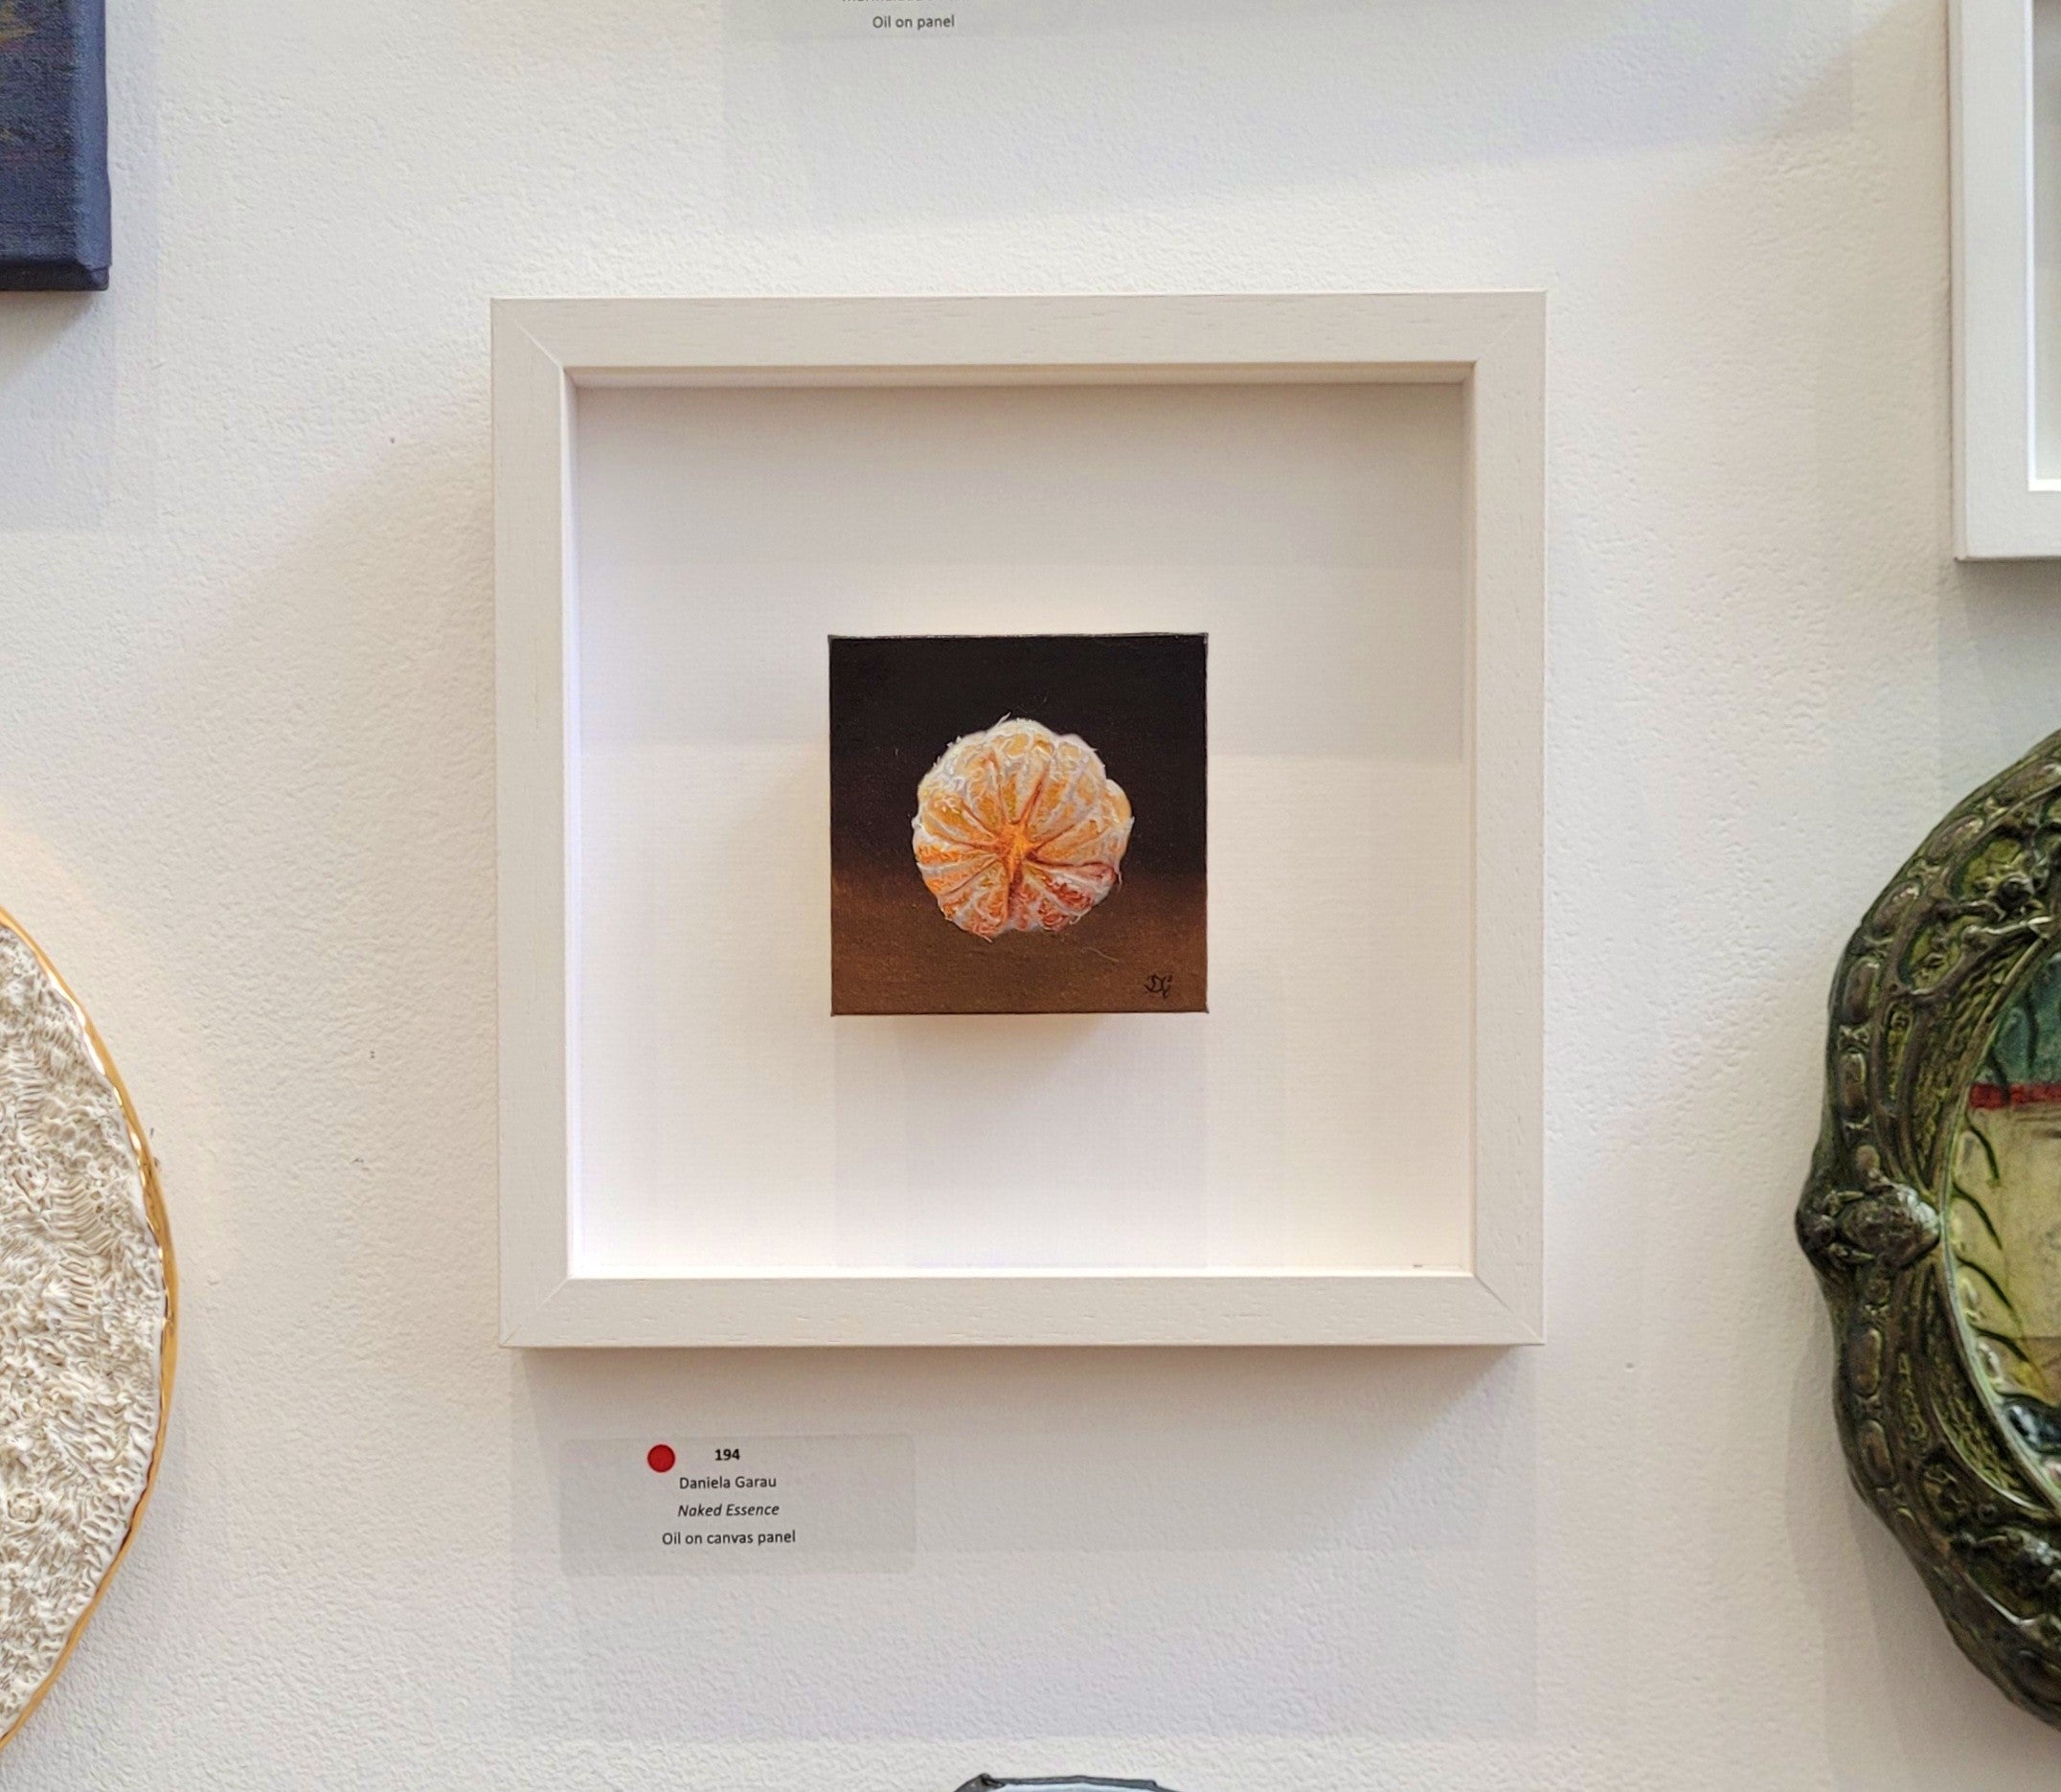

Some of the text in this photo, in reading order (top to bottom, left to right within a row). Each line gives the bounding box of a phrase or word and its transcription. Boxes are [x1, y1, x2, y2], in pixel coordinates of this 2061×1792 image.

[872, 14, 955, 31] Oil on panel
[714, 1448, 740, 1462] 194
[679, 1476, 777, 1489] Daniela Garau
[677, 1504, 781, 1517] Naked Essence
[662, 1530, 796, 1546] Oil on canvas panel
